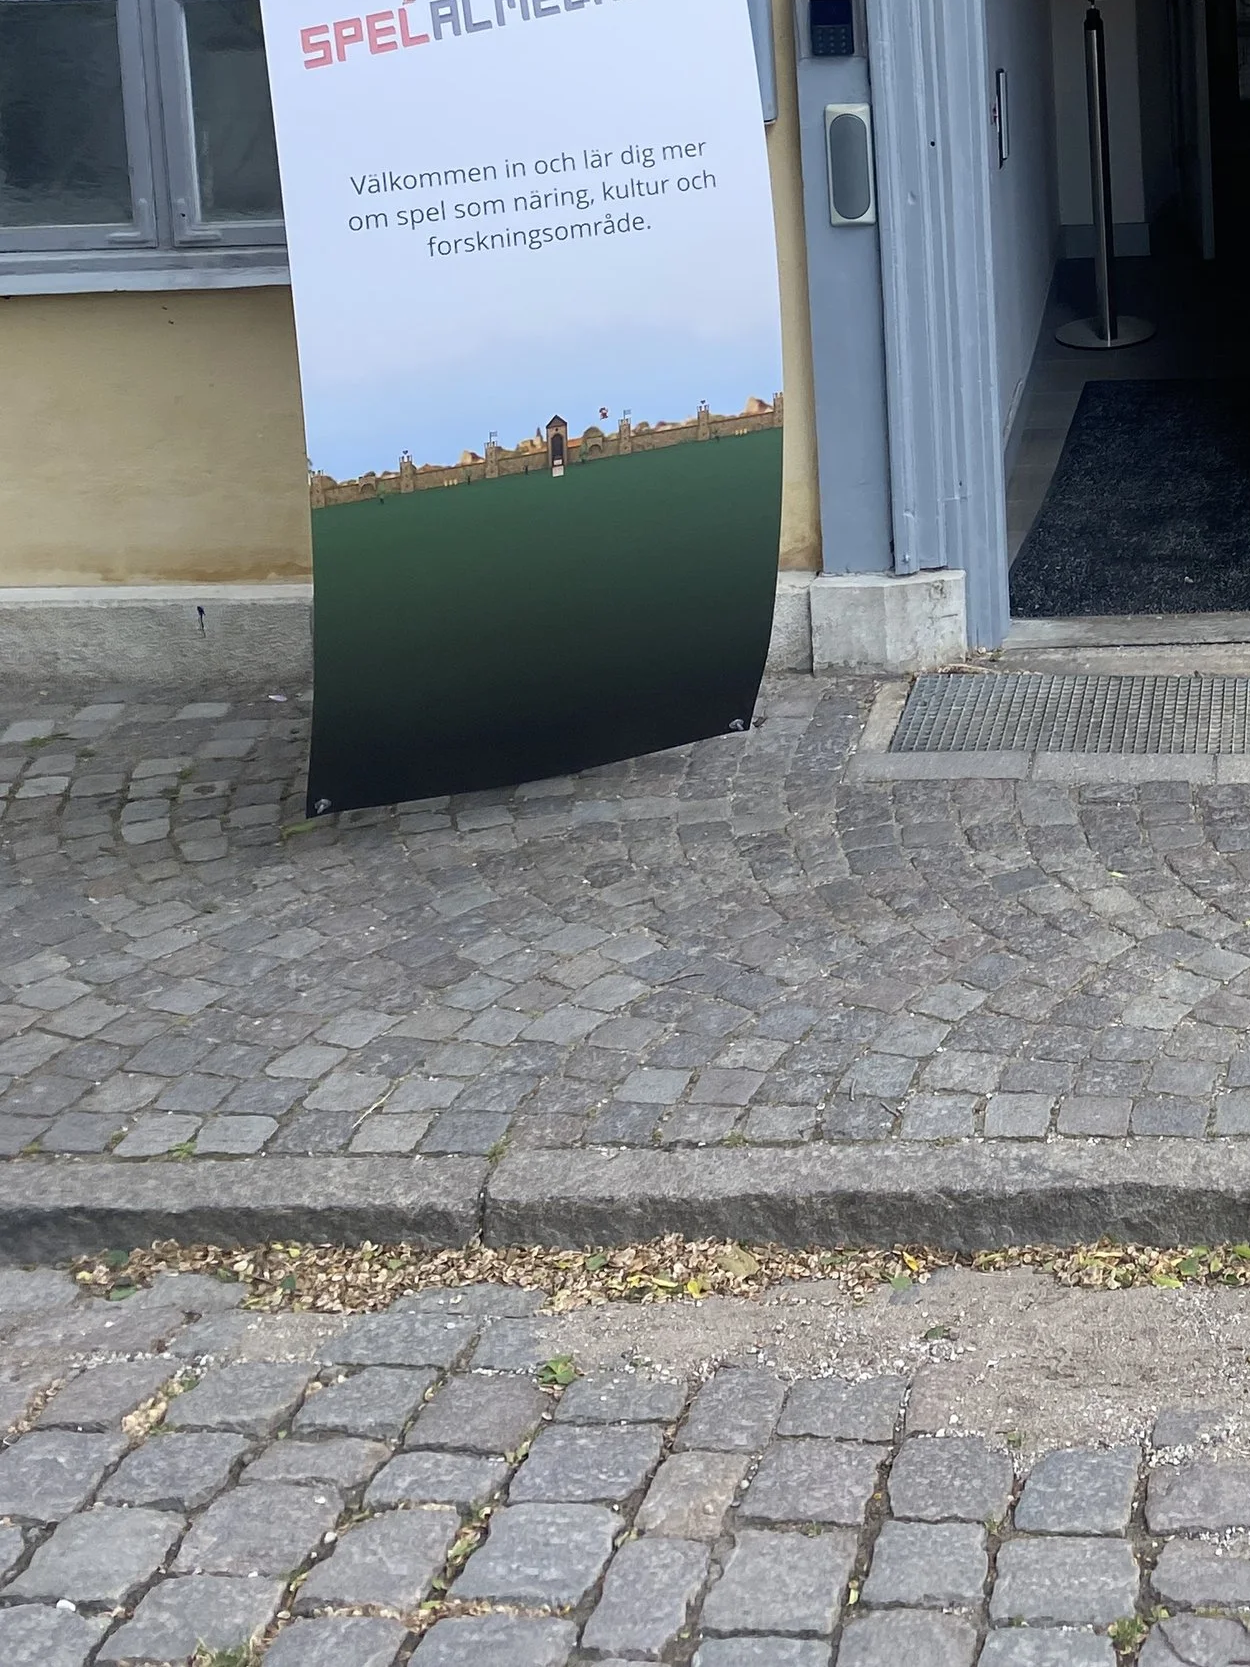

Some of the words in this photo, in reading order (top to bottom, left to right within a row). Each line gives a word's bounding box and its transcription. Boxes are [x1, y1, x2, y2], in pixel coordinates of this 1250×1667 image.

[350, 164, 498, 196] Välkommen
[505, 159, 527, 179] in
[534, 152, 577, 176] och
[583, 148, 614, 170] lär
[620, 145, 656, 169] dig
[661, 140, 707, 161] mer
[348, 211, 389, 232] om
[396, 200, 447, 231] spel
[454, 198, 506, 220] som
[513, 187, 595, 210] näring,
[602, 178, 670, 202] kultur
[677, 169, 717, 193] och
[427, 212, 652, 258] forskningsområde.
